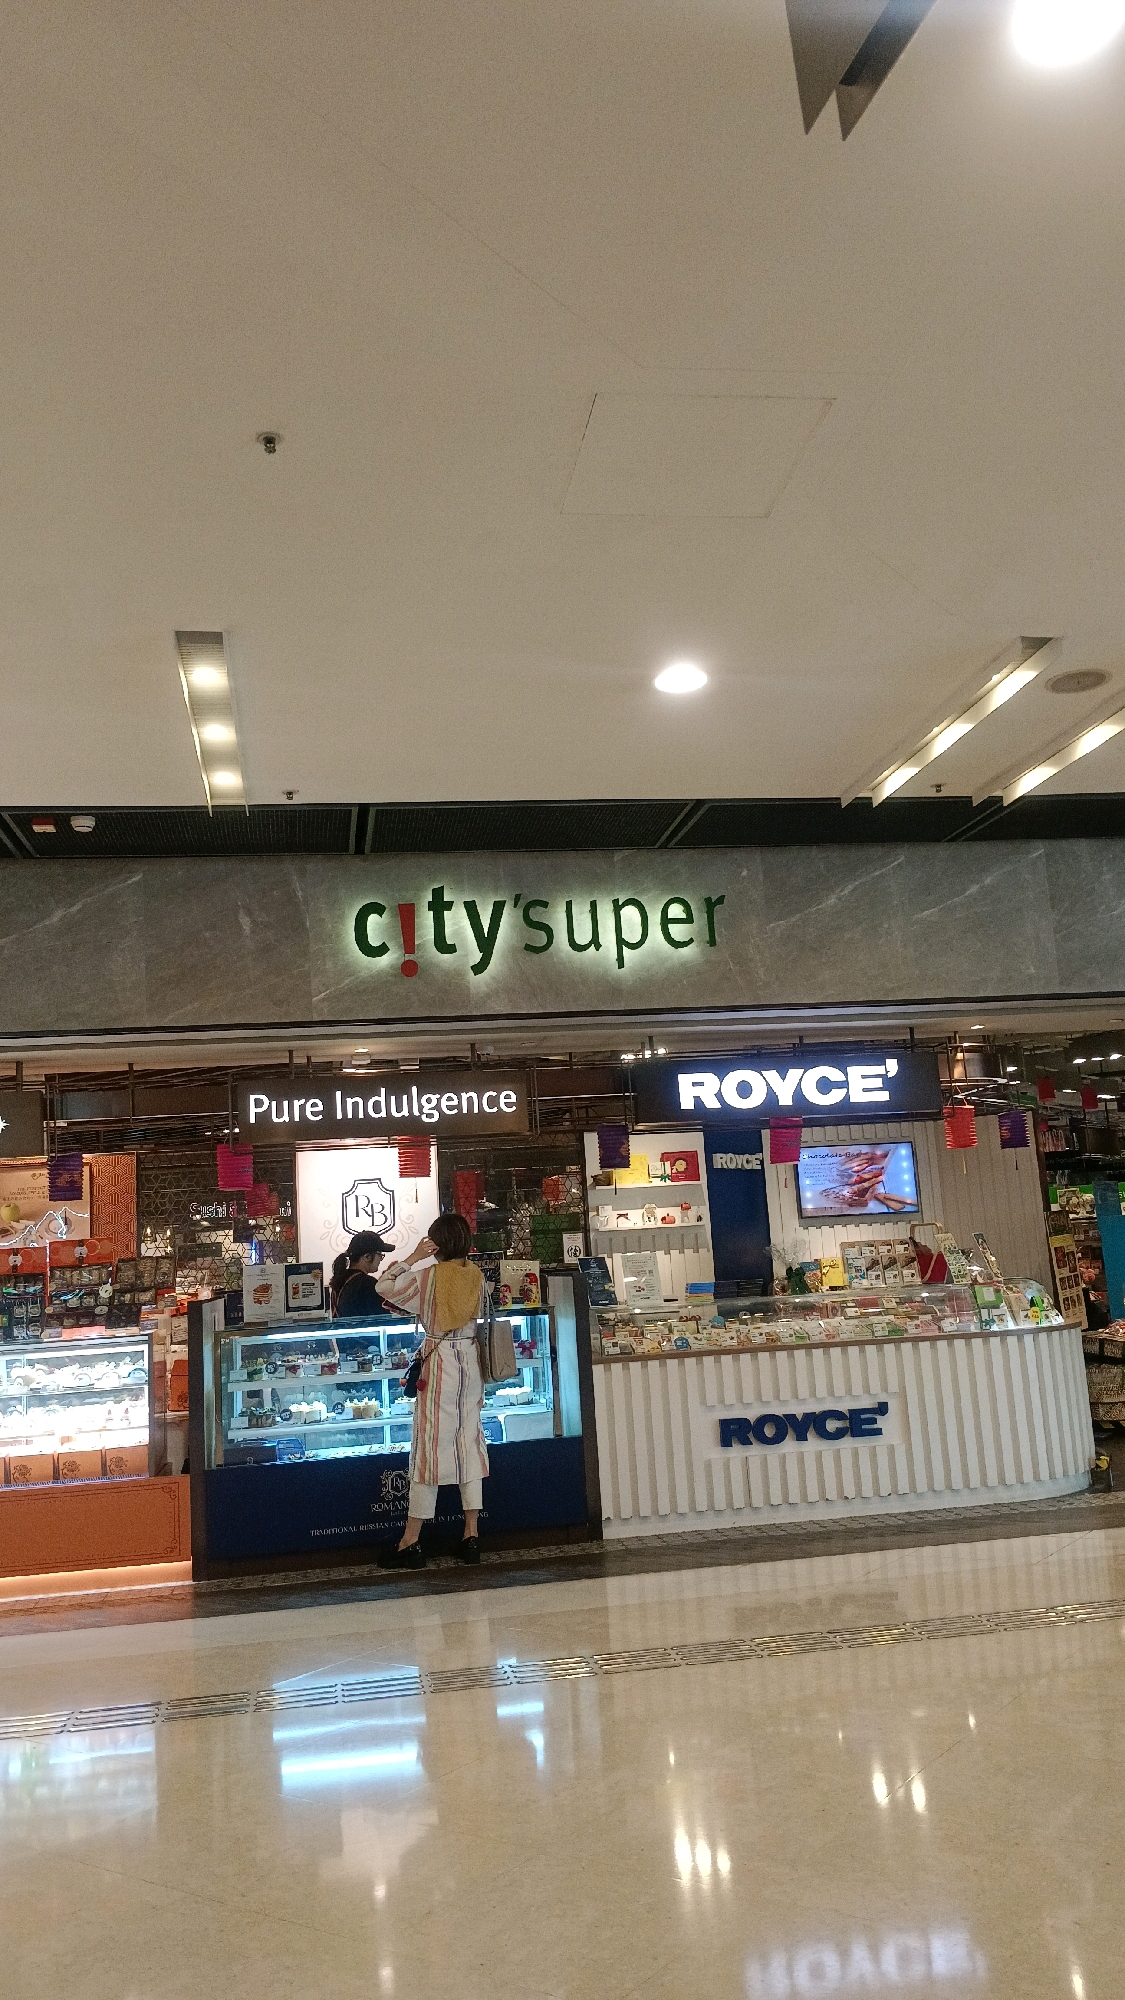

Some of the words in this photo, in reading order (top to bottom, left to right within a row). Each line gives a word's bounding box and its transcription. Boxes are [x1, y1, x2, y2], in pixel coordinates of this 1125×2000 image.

[677, 1058, 899, 1110] ROYCE'
[249, 1093, 324, 1124] Pure
[335, 1085, 517, 1123] Indulgence
[189, 1201, 227, 1218] Sushi
[718, 1401, 889, 1448] ROYCE'
[309, 1525, 358, 1537] TRADITIONAL
[359, 1522, 390, 1531] RUSSIAN
